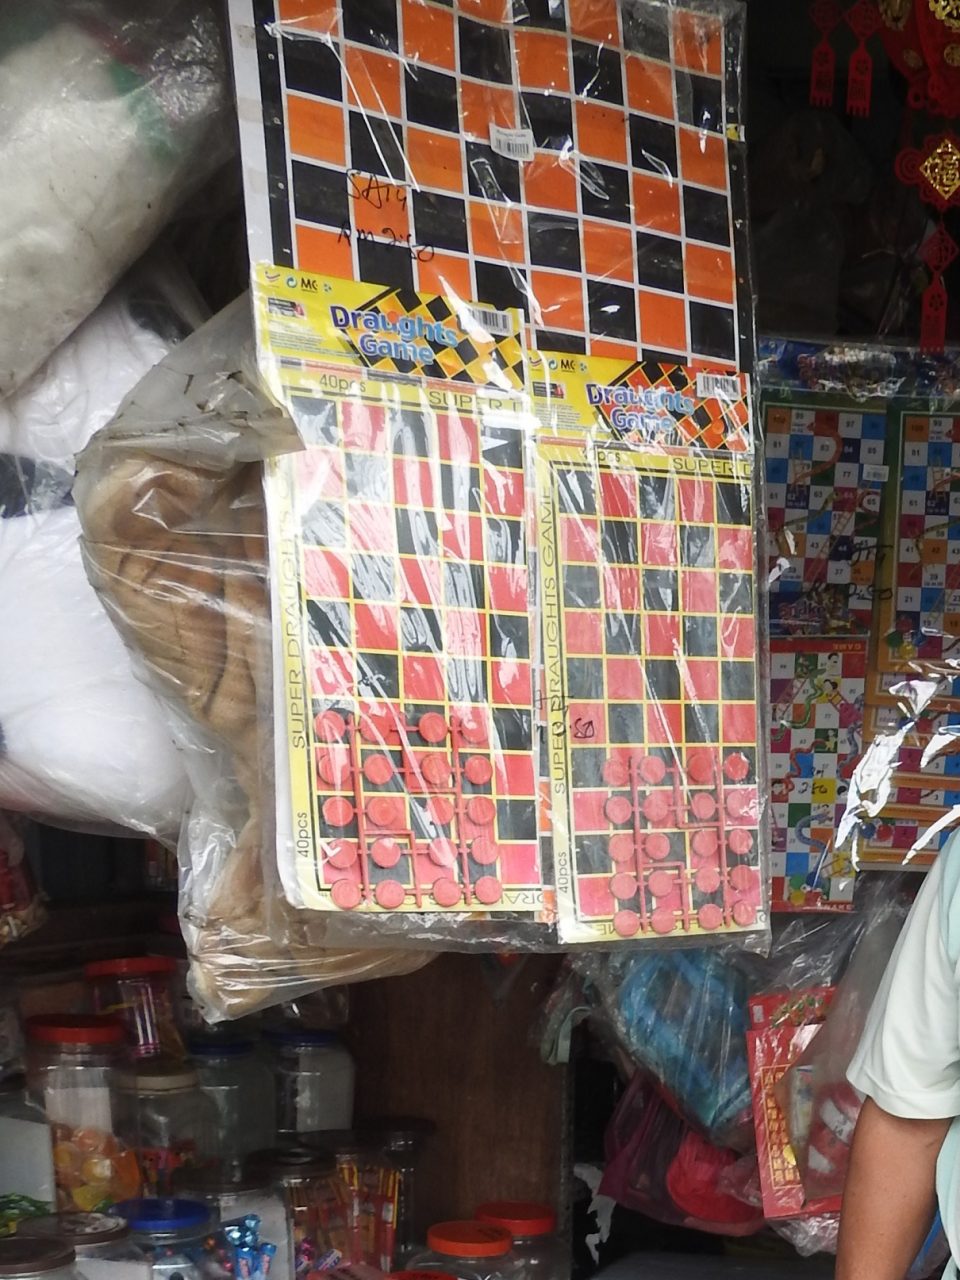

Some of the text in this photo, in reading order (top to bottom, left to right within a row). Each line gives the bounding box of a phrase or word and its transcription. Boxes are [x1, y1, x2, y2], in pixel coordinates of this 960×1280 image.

[330, 305, 458, 347] Draughts
[359, 334, 434, 365] Game
[585, 383, 695, 417] Draughts
[611, 407, 674, 431] Game
[289, 668, 306, 749] SUPER
